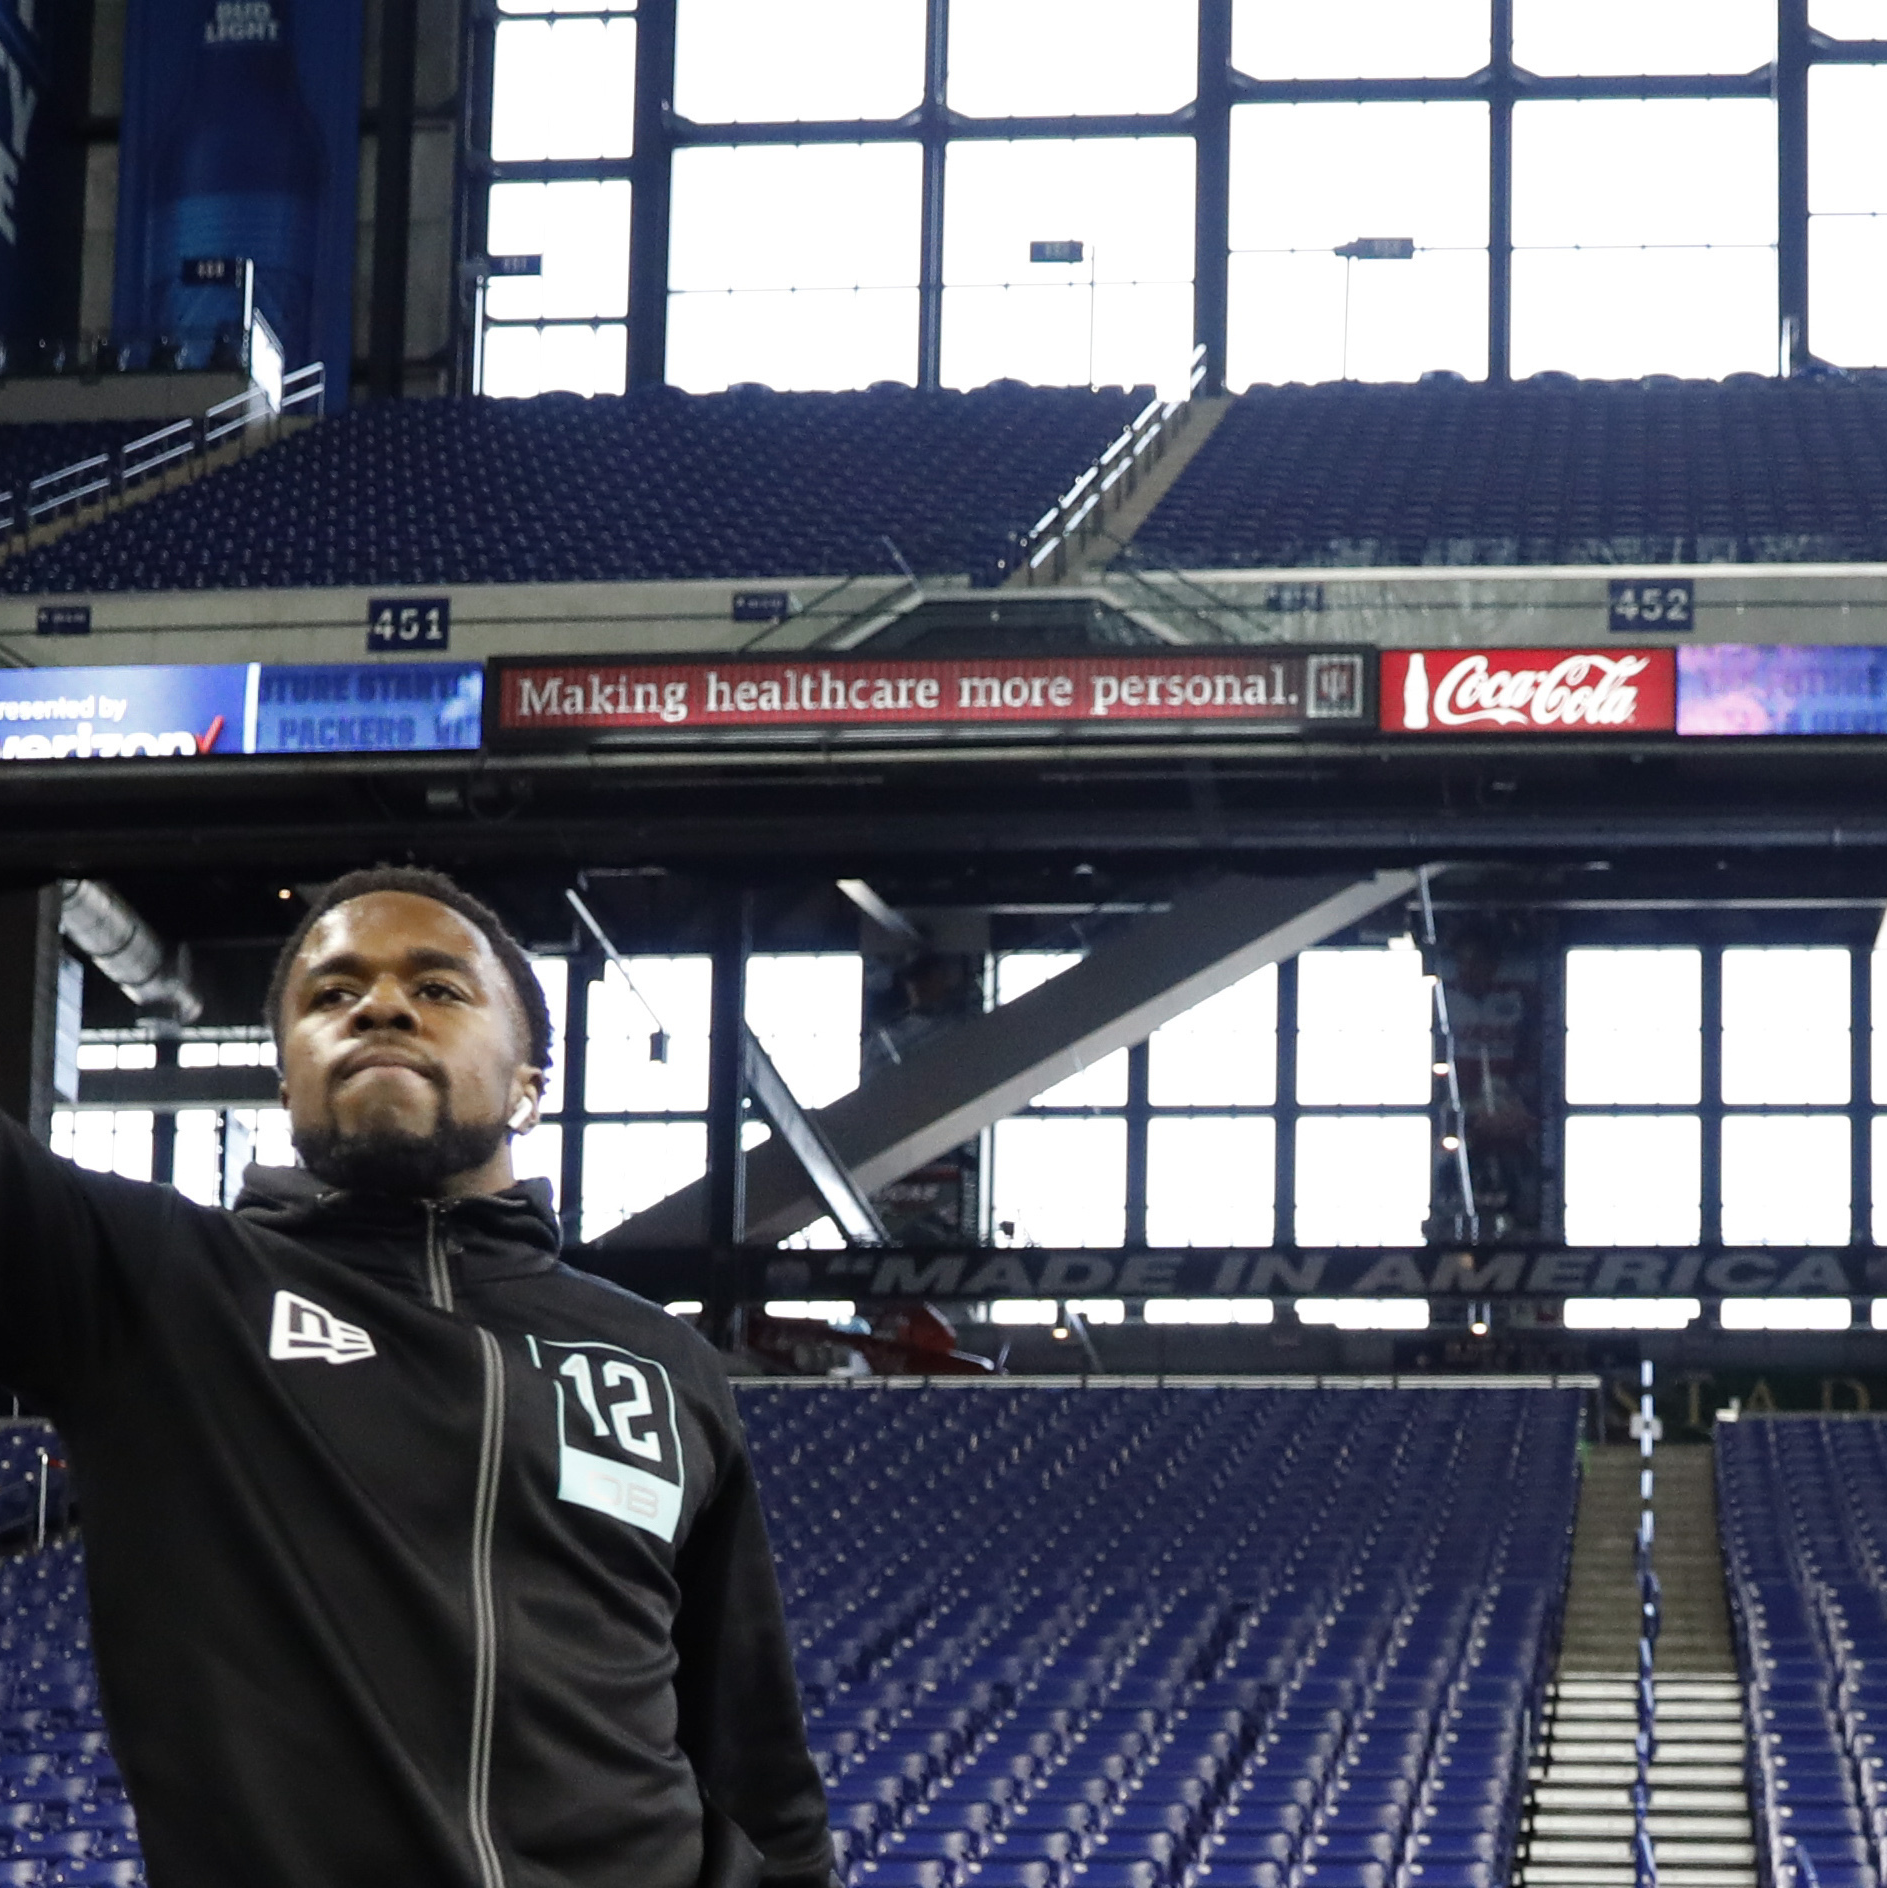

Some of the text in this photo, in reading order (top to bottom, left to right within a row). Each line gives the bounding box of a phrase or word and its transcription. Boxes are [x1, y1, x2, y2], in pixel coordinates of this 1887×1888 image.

[373, 608, 444, 641] 451
[1615, 587, 1691, 623] 452
[100, 696, 127, 723] by
[517, 664, 1300, 724] Making healthcare more personal.
[1433, 653, 1652, 728] Coca-Cola
[1213, 1254, 1313, 1296] IN
[1352, 1252, 1853, 1294] AMERICA
[558, 1352, 663, 1464] 12
